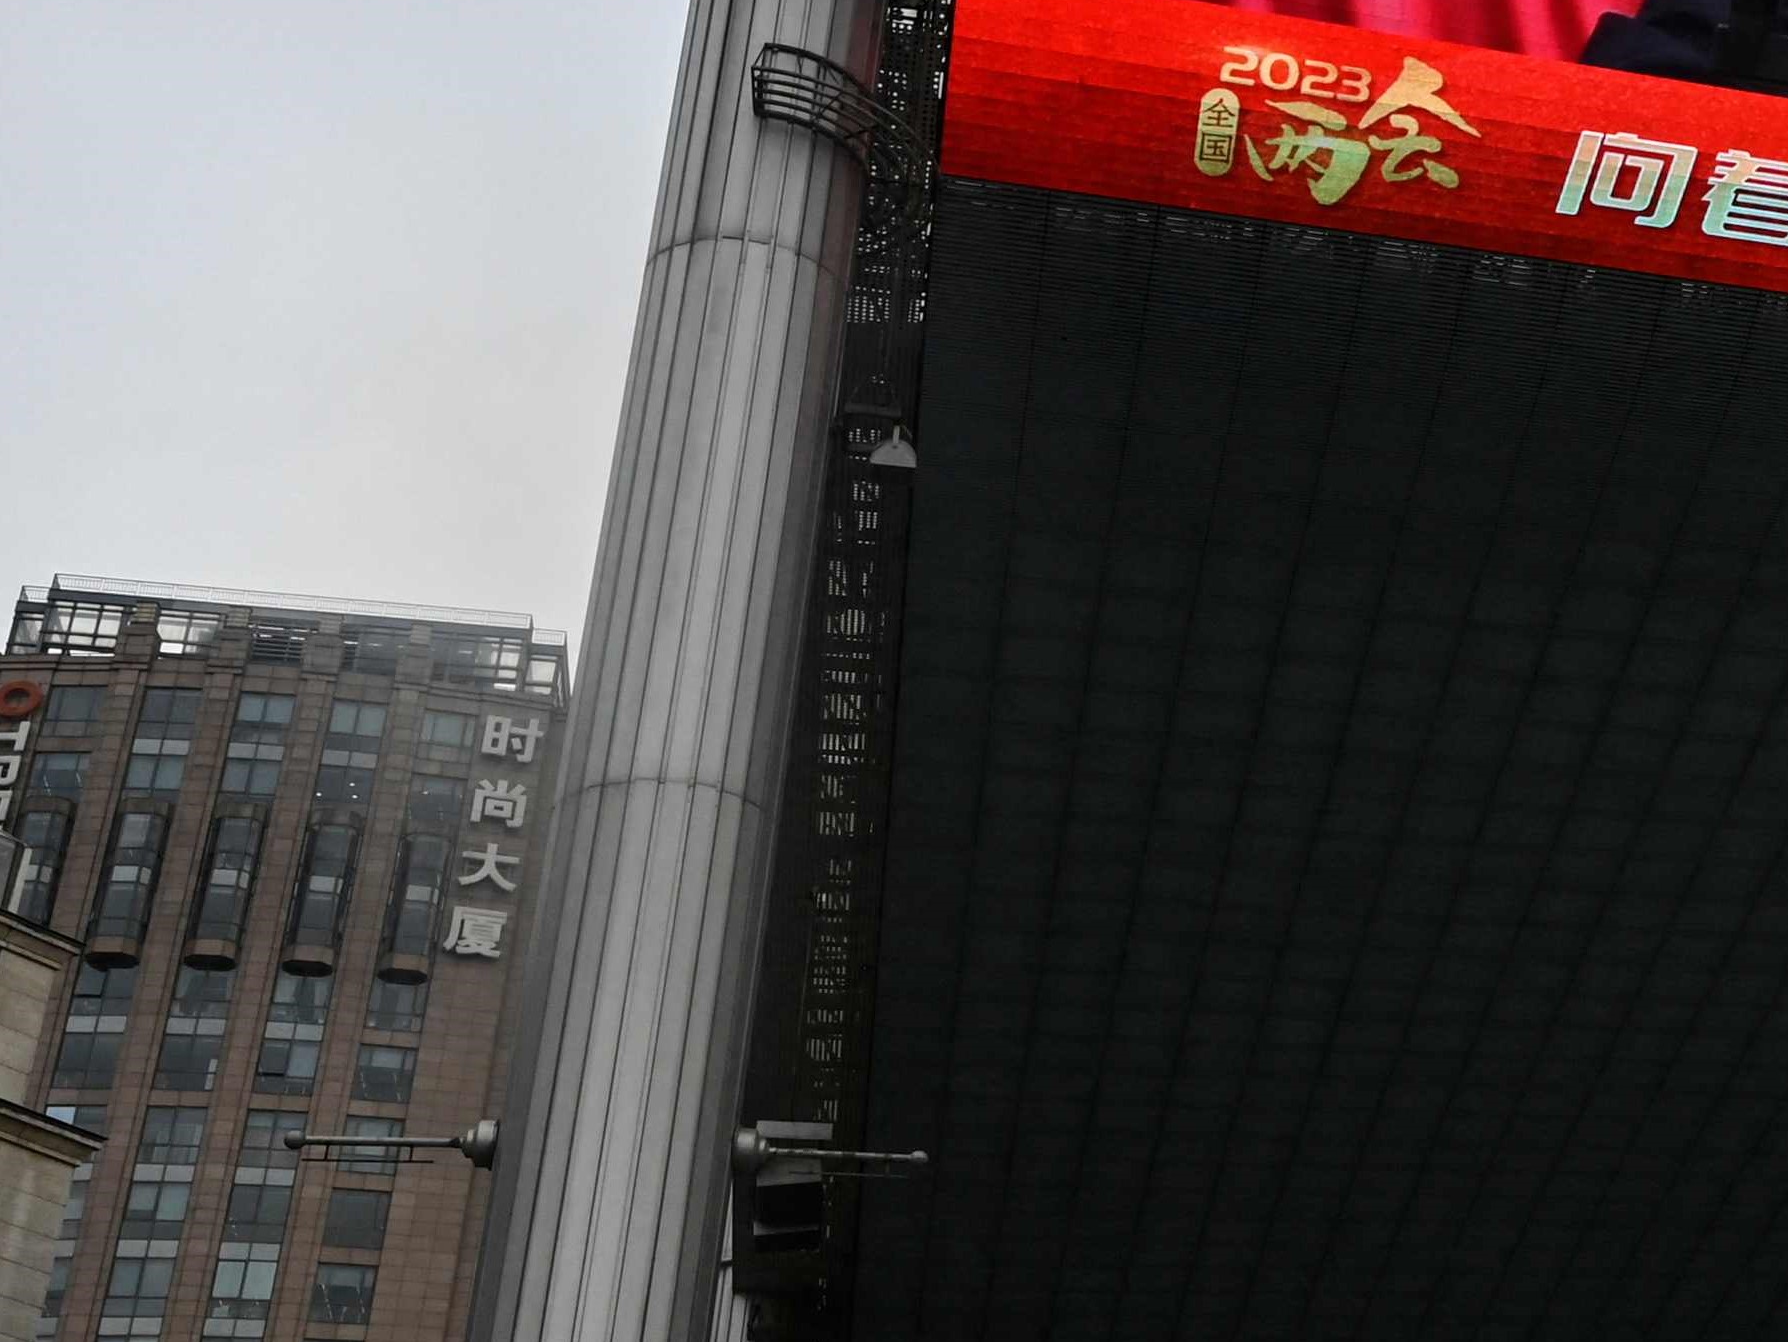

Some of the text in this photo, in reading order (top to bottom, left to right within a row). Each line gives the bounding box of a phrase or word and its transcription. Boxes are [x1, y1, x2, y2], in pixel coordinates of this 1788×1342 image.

[1219, 46, 1373, 104] 2023
[1199, 97, 1237, 164] 全国
[1243, 55, 1483, 206] 两会
[443, 714, 544, 958] 时尚大厦
